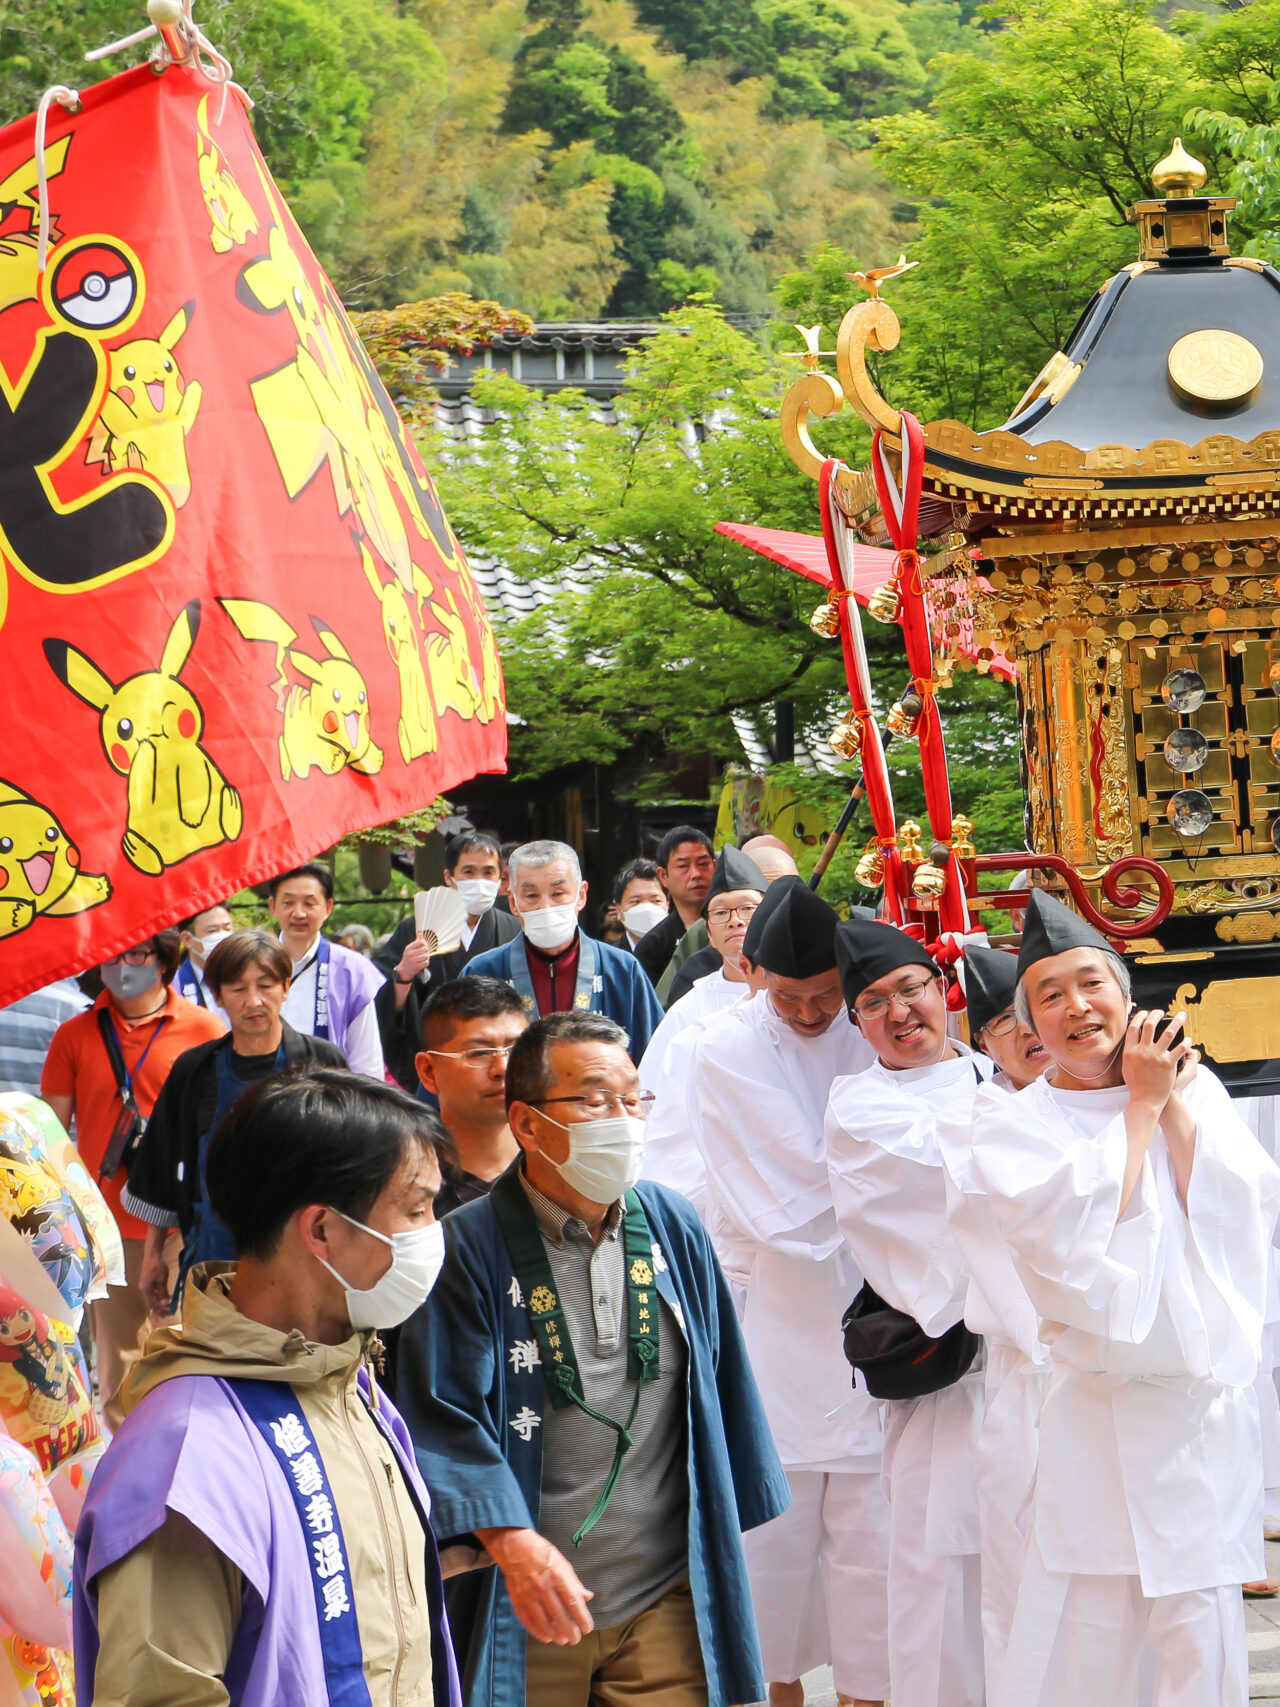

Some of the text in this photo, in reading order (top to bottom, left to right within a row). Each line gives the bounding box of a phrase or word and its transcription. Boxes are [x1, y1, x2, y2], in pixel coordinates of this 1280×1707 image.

[269, 1412, 351, 1622] 修善寺温泉
